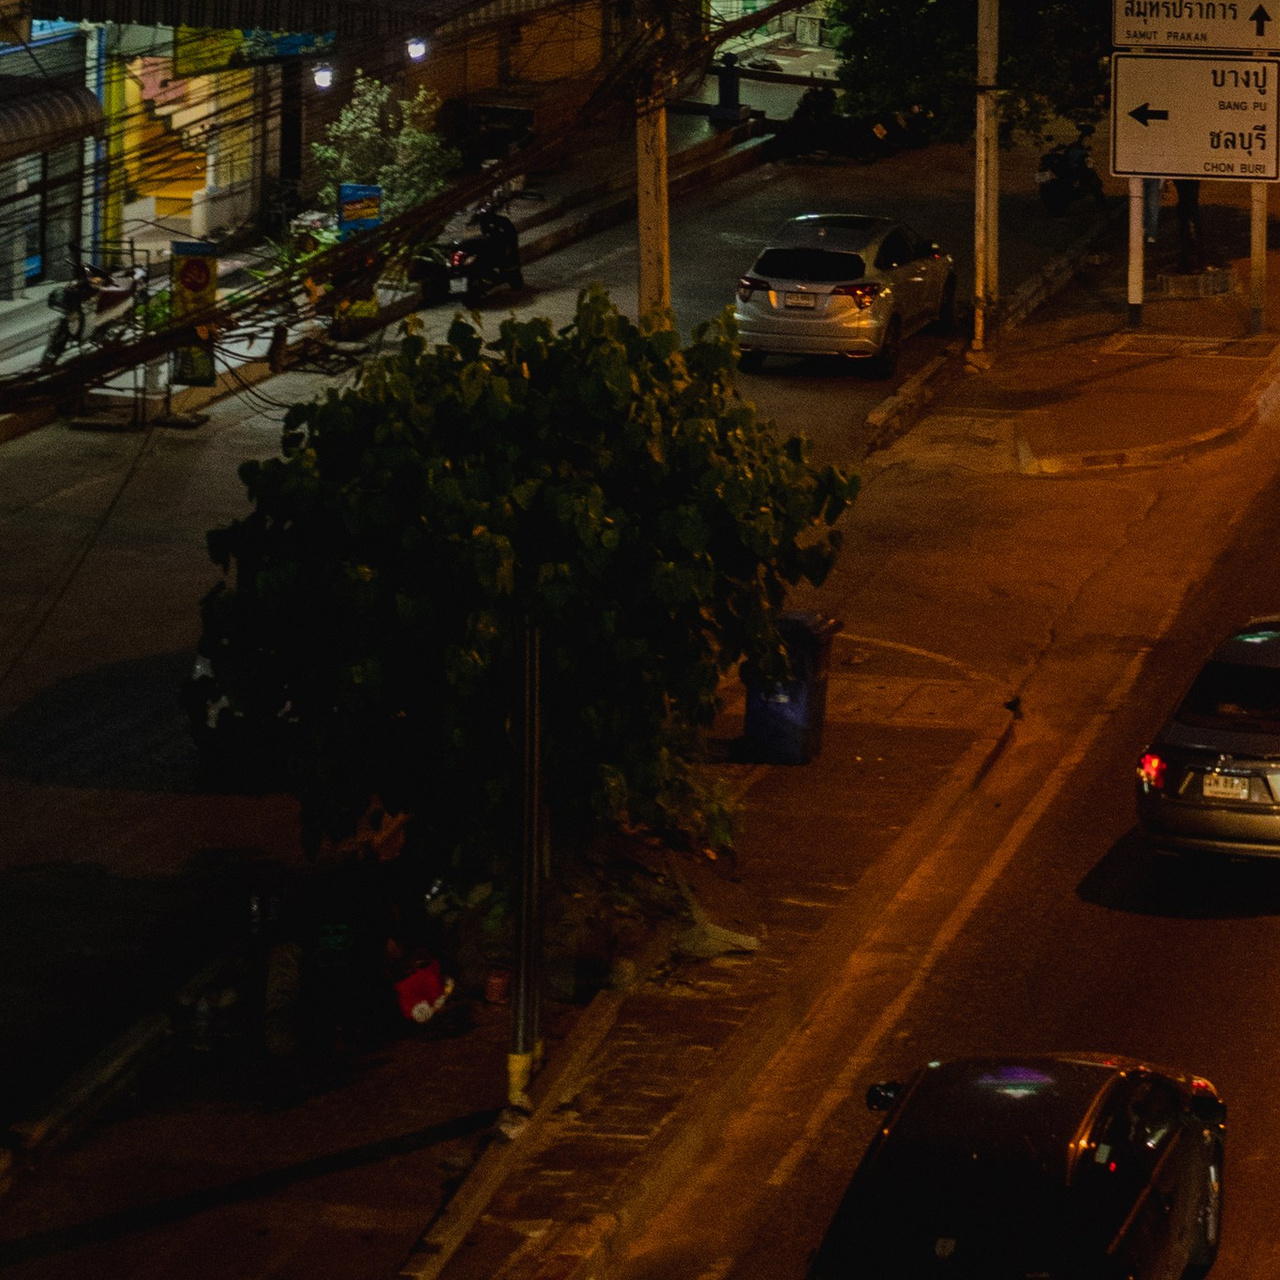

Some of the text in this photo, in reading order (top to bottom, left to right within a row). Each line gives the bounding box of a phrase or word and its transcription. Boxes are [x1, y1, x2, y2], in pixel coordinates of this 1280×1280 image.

[1125, 31, 1208, 42] SAMUT PRAKAN
[1211, 65, 1268, 95] บางปู
[1218, 101, 1268, 111] BANG PU
[1209, 125, 1267, 156] ชลบุรี
[1203, 162, 1266, 174] CHON BURI
